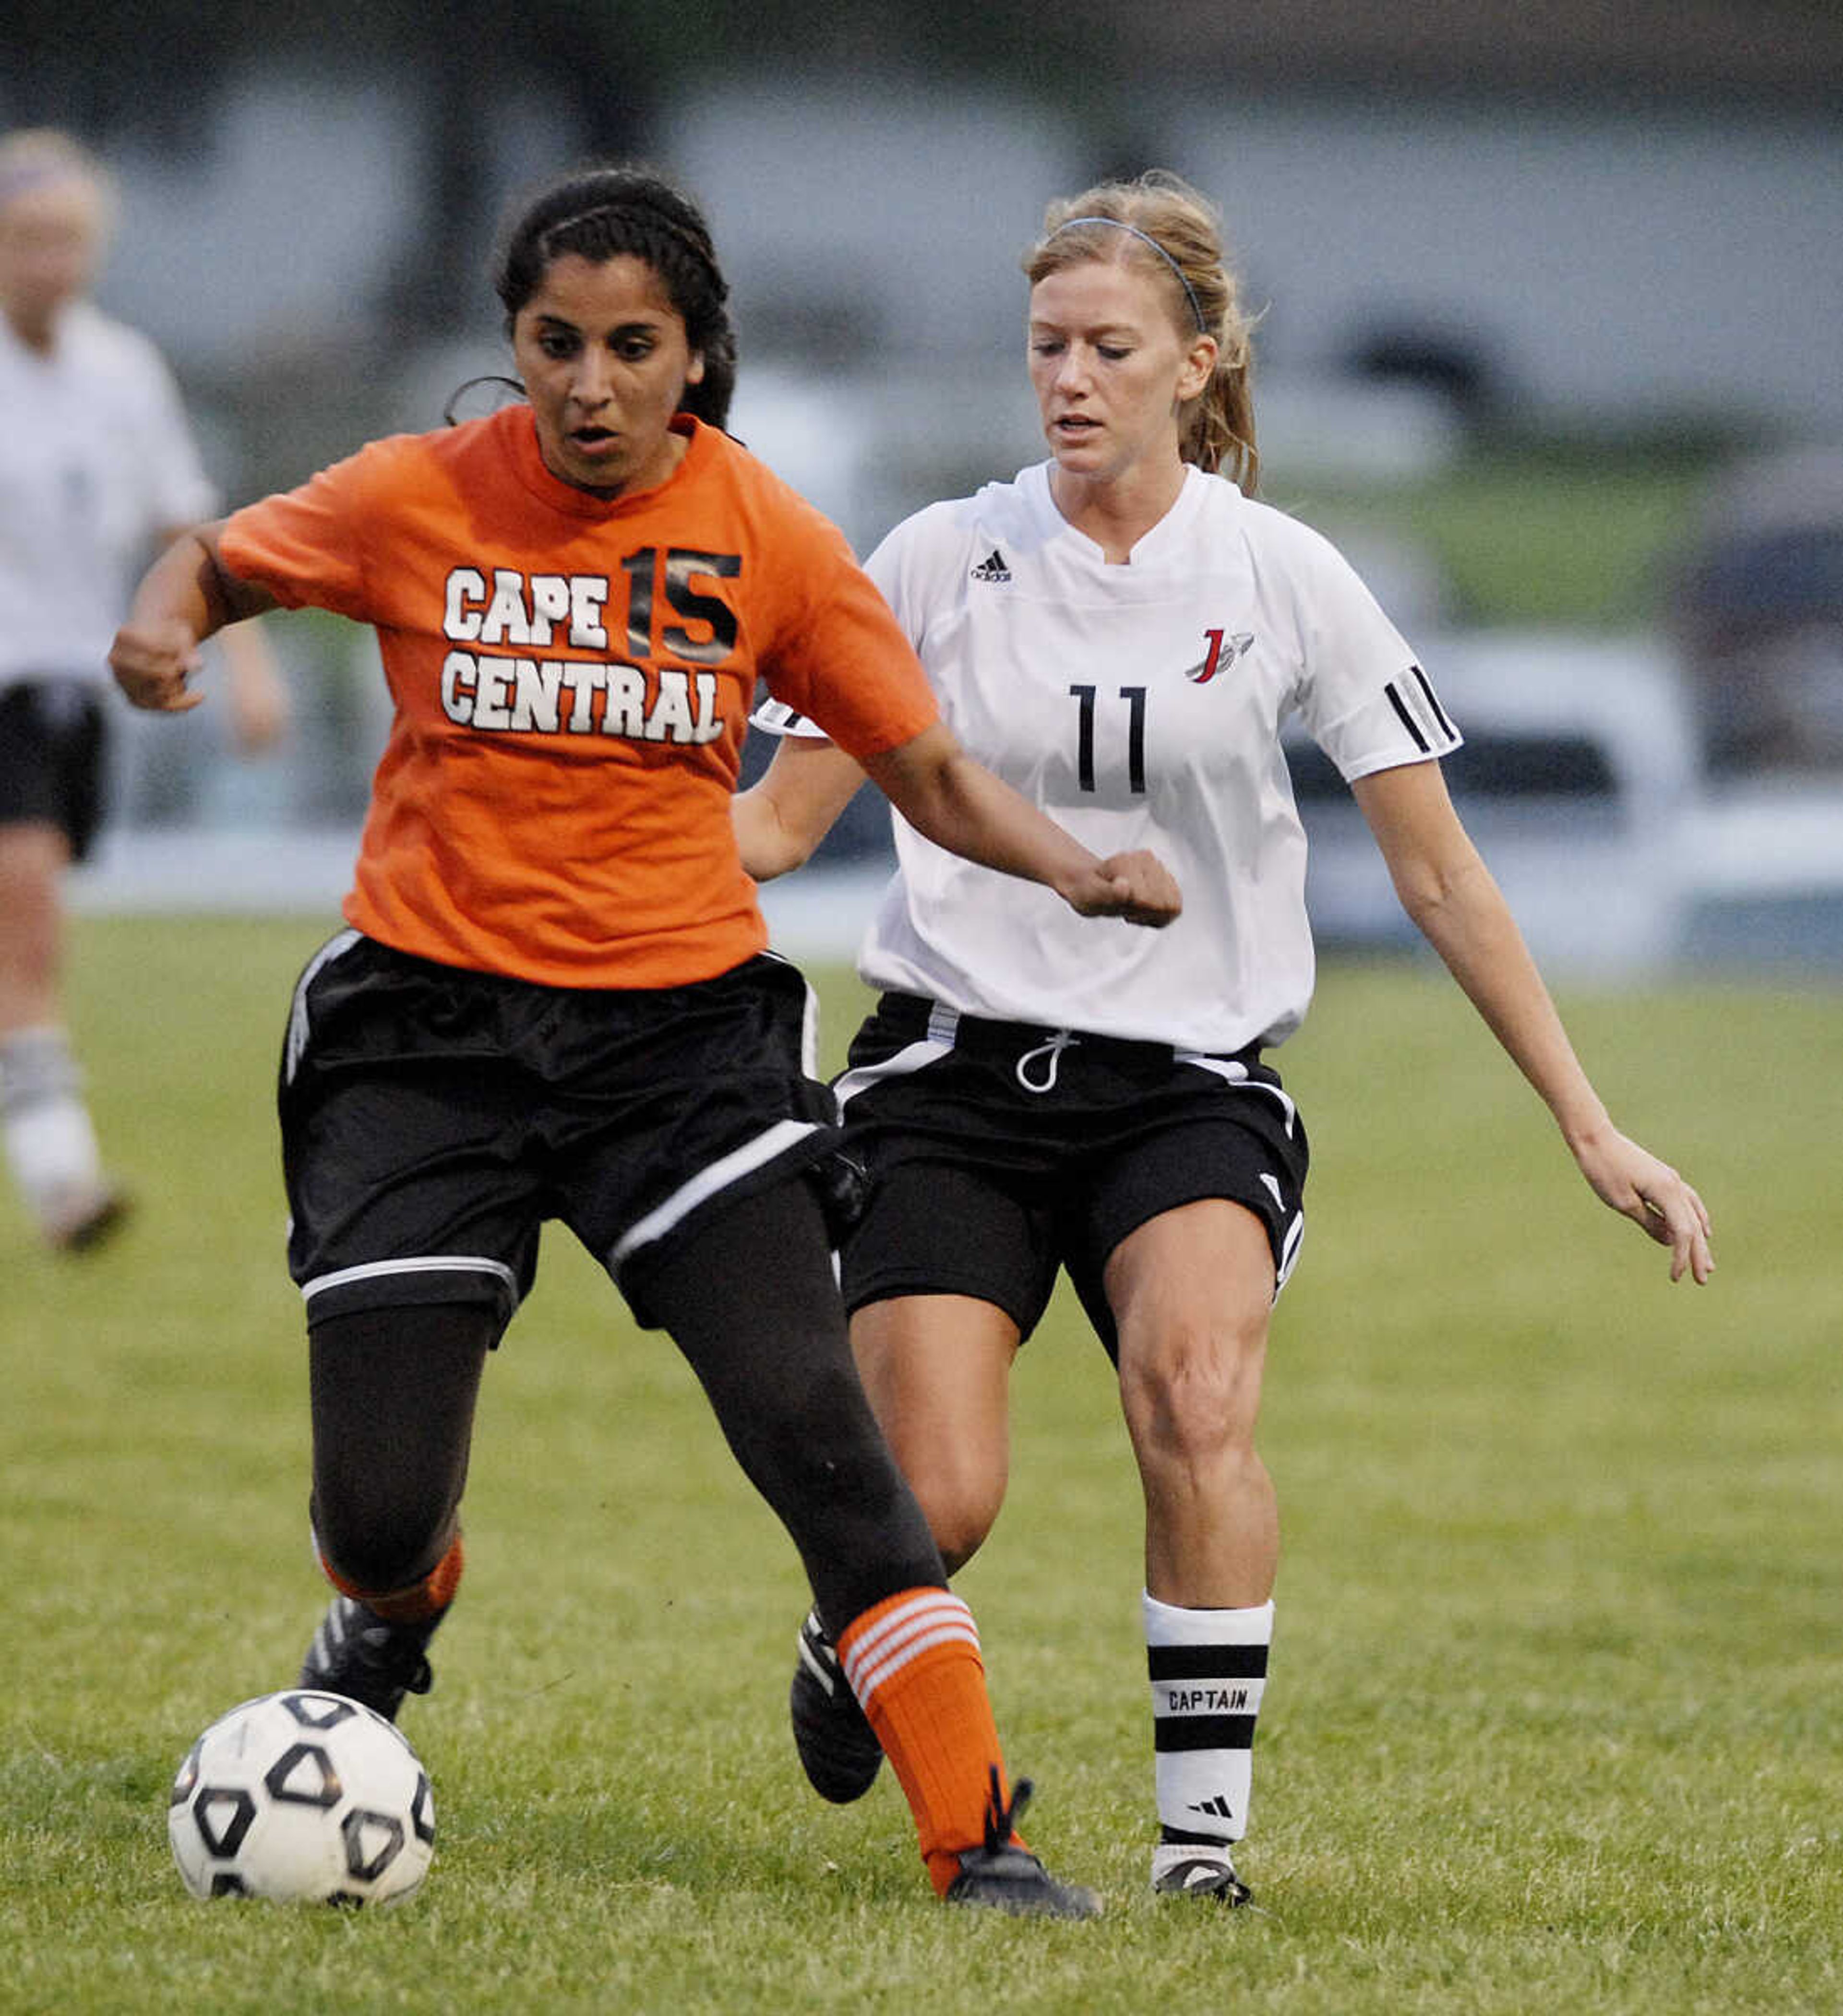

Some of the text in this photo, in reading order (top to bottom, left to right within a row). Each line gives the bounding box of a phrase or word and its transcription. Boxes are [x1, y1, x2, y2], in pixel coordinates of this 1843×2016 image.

[442, 566, 609, 649] CAPE
[621, 546, 742, 664] 15
[970, 569, 1011, 583] adidas
[440, 648, 725, 744] CENTRAL
[1069, 685, 1147, 794] 11
[1169, 1689, 1248, 1711] CAPTAIN
